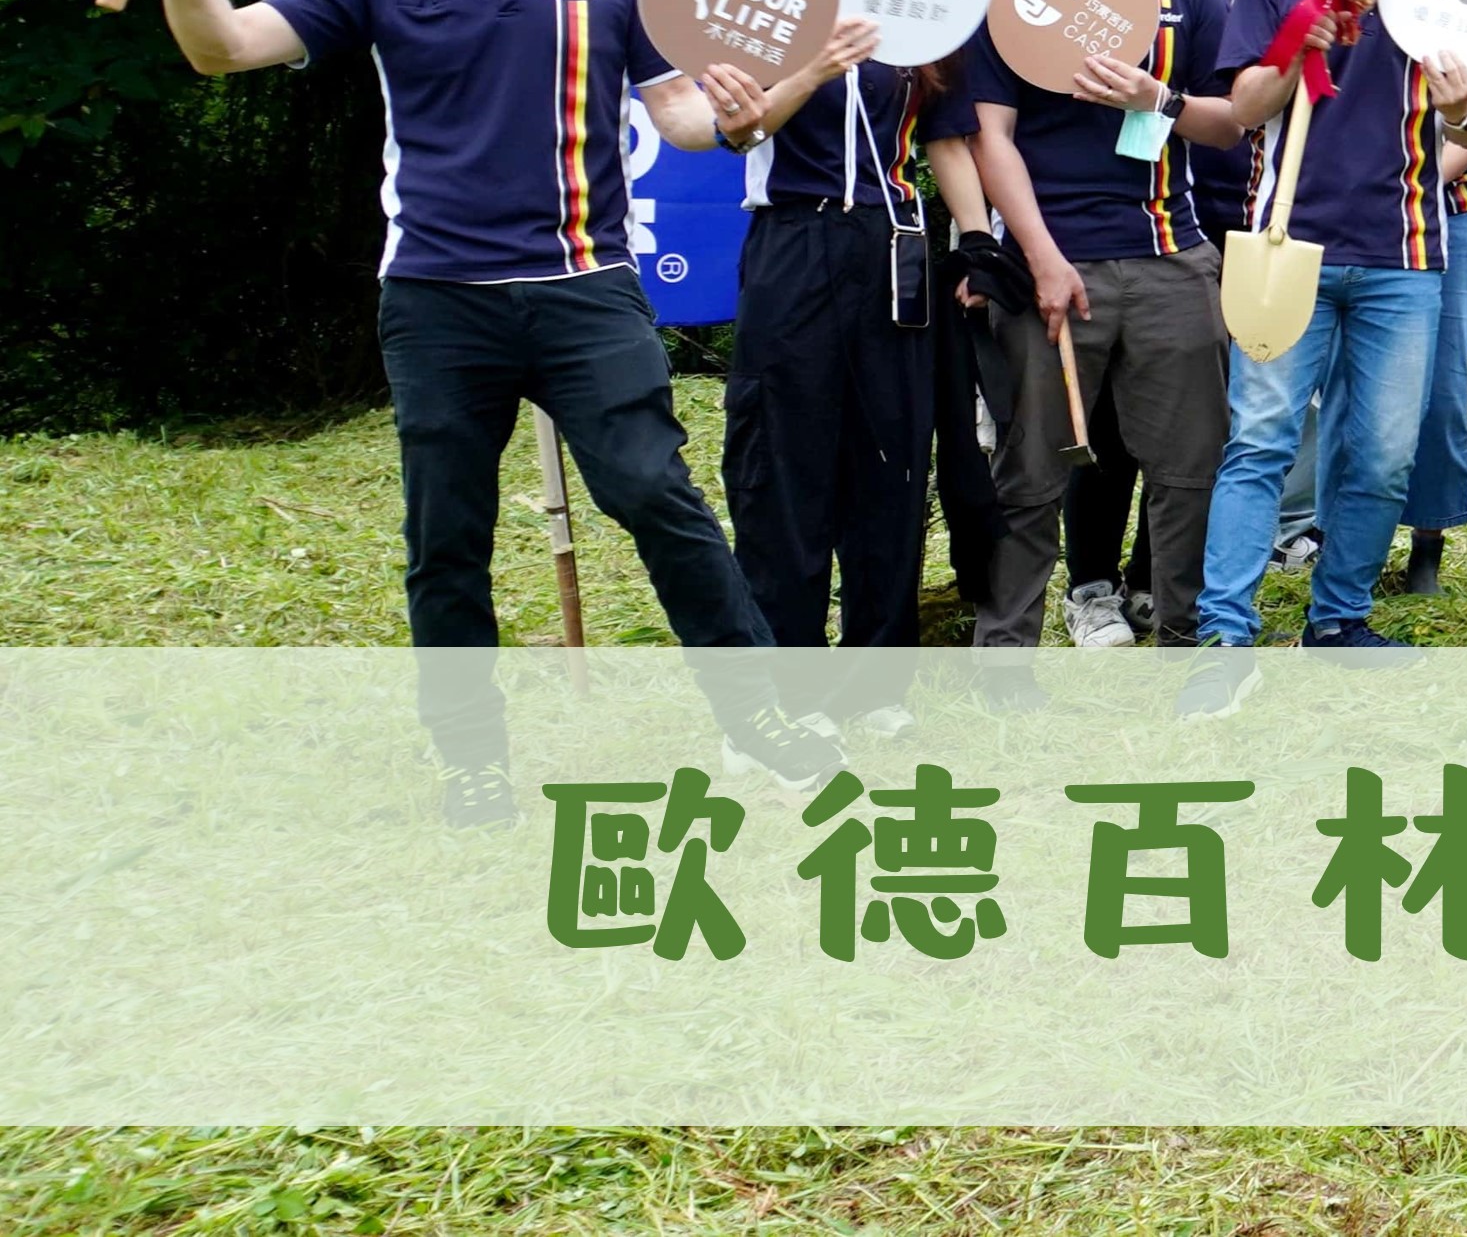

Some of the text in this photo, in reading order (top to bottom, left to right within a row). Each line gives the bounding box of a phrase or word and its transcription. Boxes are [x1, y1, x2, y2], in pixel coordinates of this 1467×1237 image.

[1074, 11, 1122, 49] CIAO
[1160, 12, 1183, 22] rder
[1063, 24, 1111, 59] CASA
